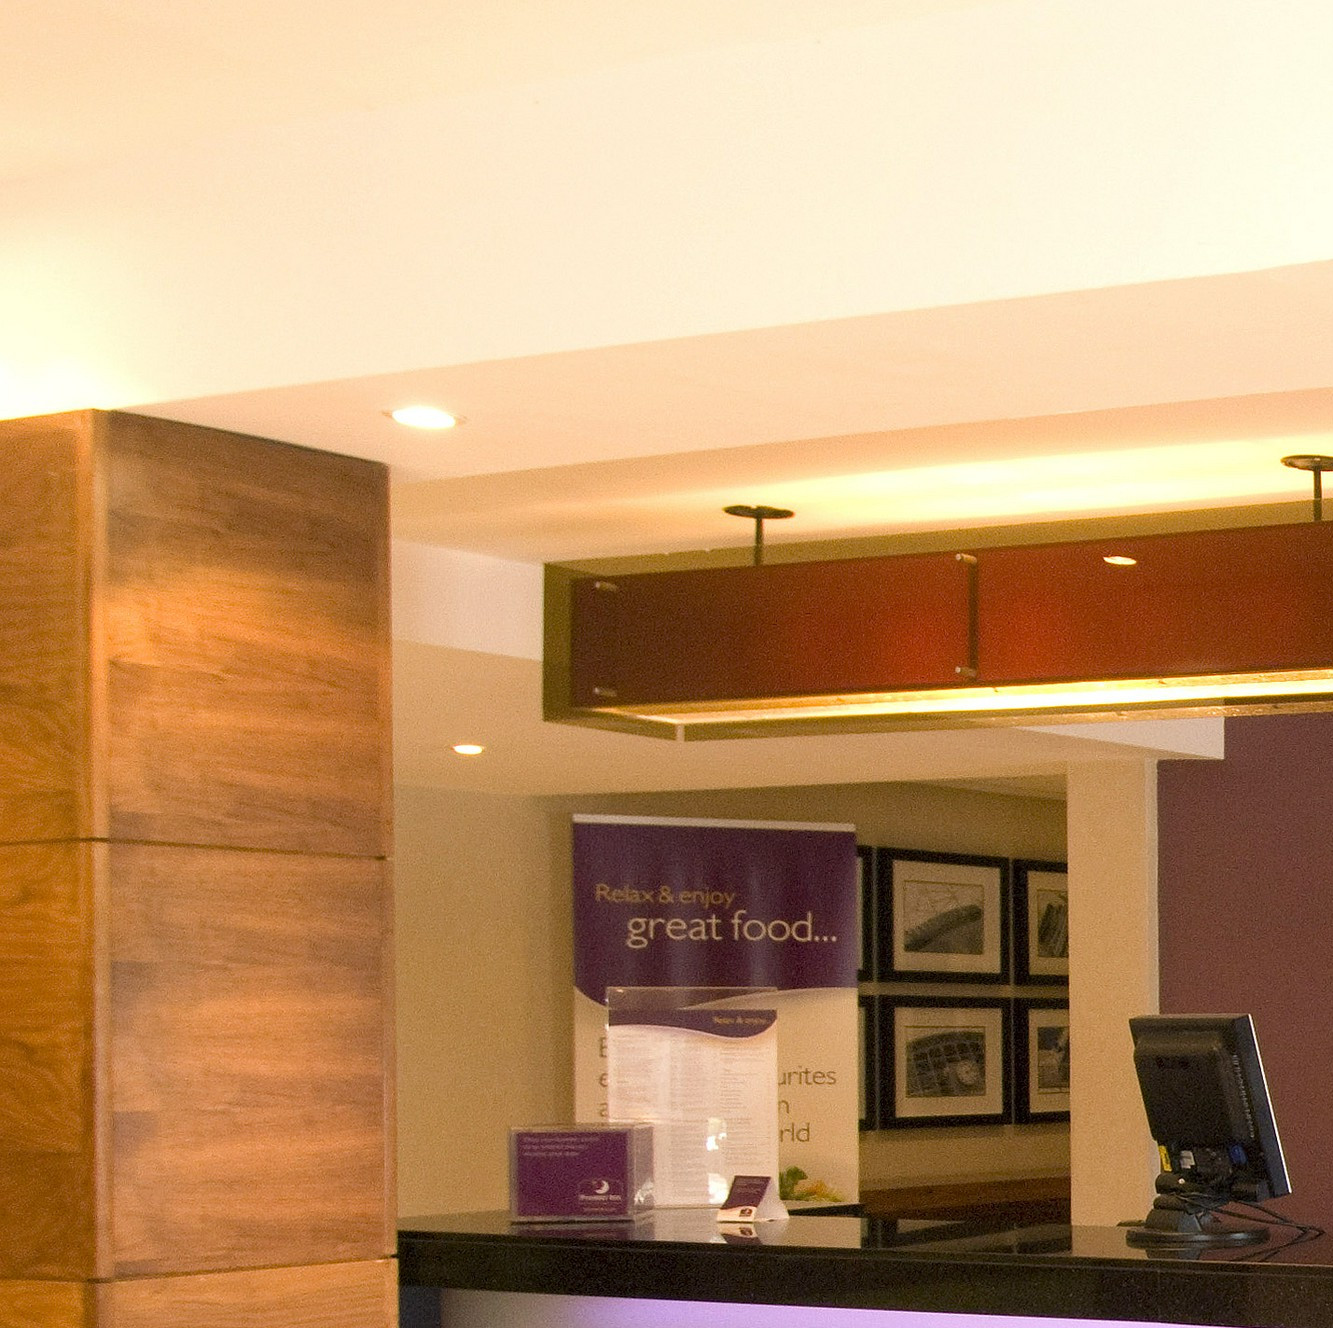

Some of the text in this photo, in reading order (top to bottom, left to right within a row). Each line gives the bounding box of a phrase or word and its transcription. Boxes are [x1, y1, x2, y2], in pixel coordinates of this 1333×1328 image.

[595, 883, 736, 909] Relax & enjoy
[627, 910, 837, 949] great food...
[778, 1065, 837, 1086] urites
[779, 1122, 811, 1143] rld
